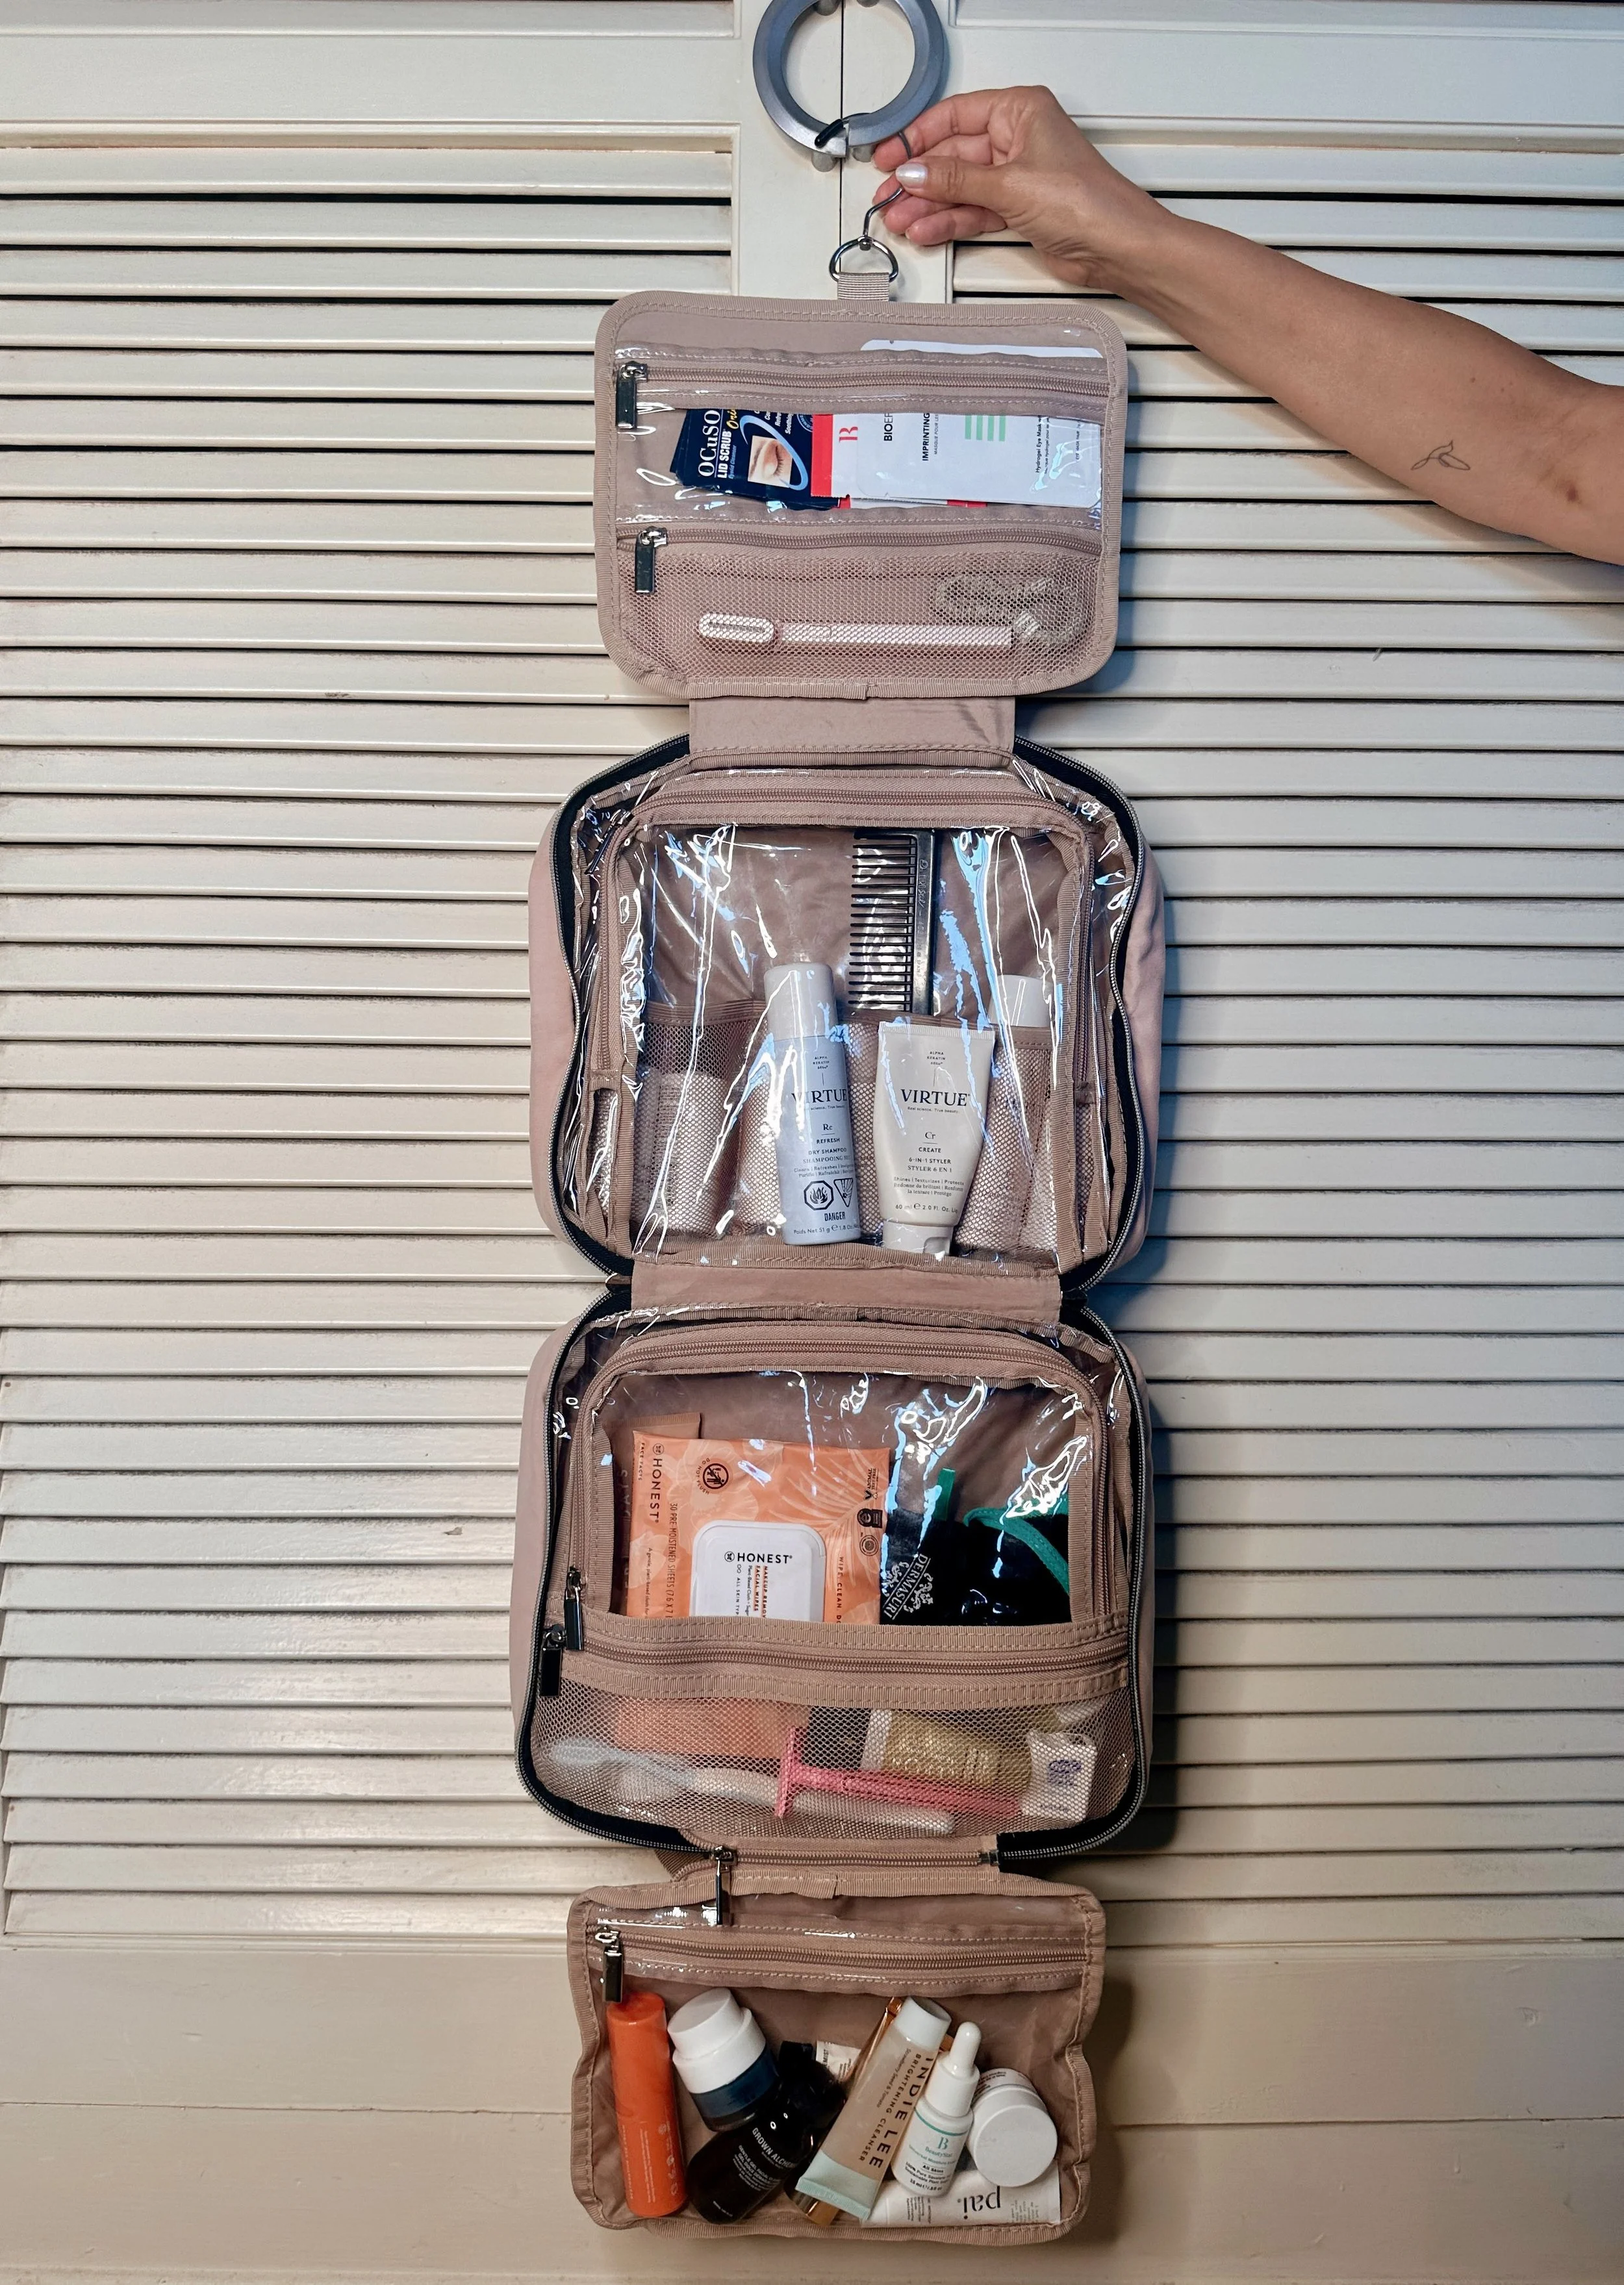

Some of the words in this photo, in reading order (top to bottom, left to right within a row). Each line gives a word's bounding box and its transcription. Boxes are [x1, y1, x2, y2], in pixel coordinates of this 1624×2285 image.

[922, 412, 930, 461] IMPRINTING
[717, 462, 728, 479] LID
[900, 1089, 968, 1106] VIRTUE
[824, 1211, 846, 1222] DANGER
[650, 1458, 663, 1520] HONEST
[696, 1480, 710, 1495] FLUSH
[737, 1552, 790, 1564] HONEST
[667, 1565, 676, 1587] SHEETS
[884, 1554, 928, 1619] DERMASURI
[886, 2054, 921, 2114] BRIGHTENING
[895, 2058, 933, 2121] INDIE
[739, 2145, 751, 2162] GENTLE
[752, 2127, 773, 2155] GROWN
[859, 2118, 886, 2161] CLEANSER
[869, 2130, 897, 2168] LEE
